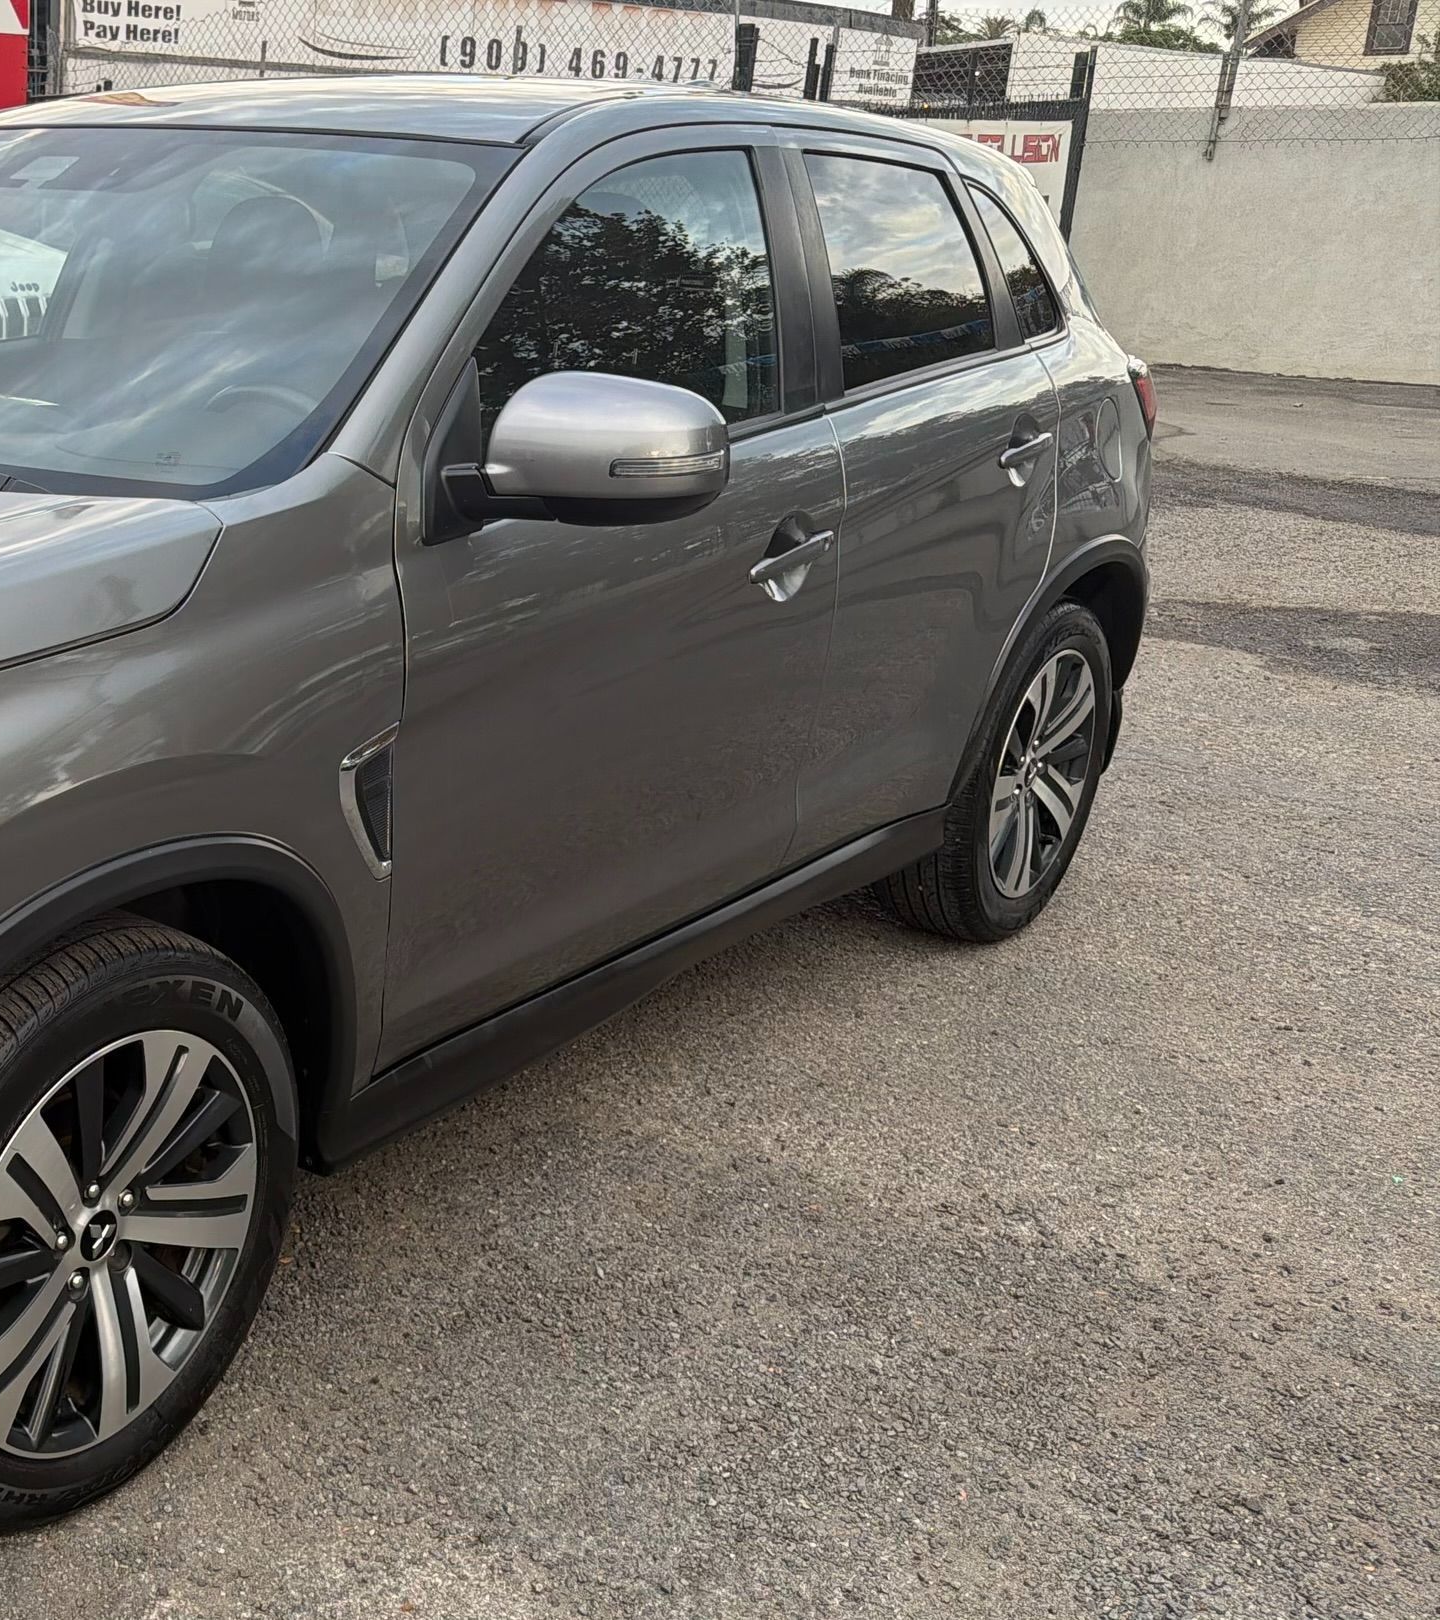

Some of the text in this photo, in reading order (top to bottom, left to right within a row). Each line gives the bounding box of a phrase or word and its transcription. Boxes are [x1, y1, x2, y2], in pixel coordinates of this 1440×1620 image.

[82, 0, 181, 21] Buy Here!
[83, 20, 179, 44] Pay Here!
[568, 47, 717, 83] 469-4777
